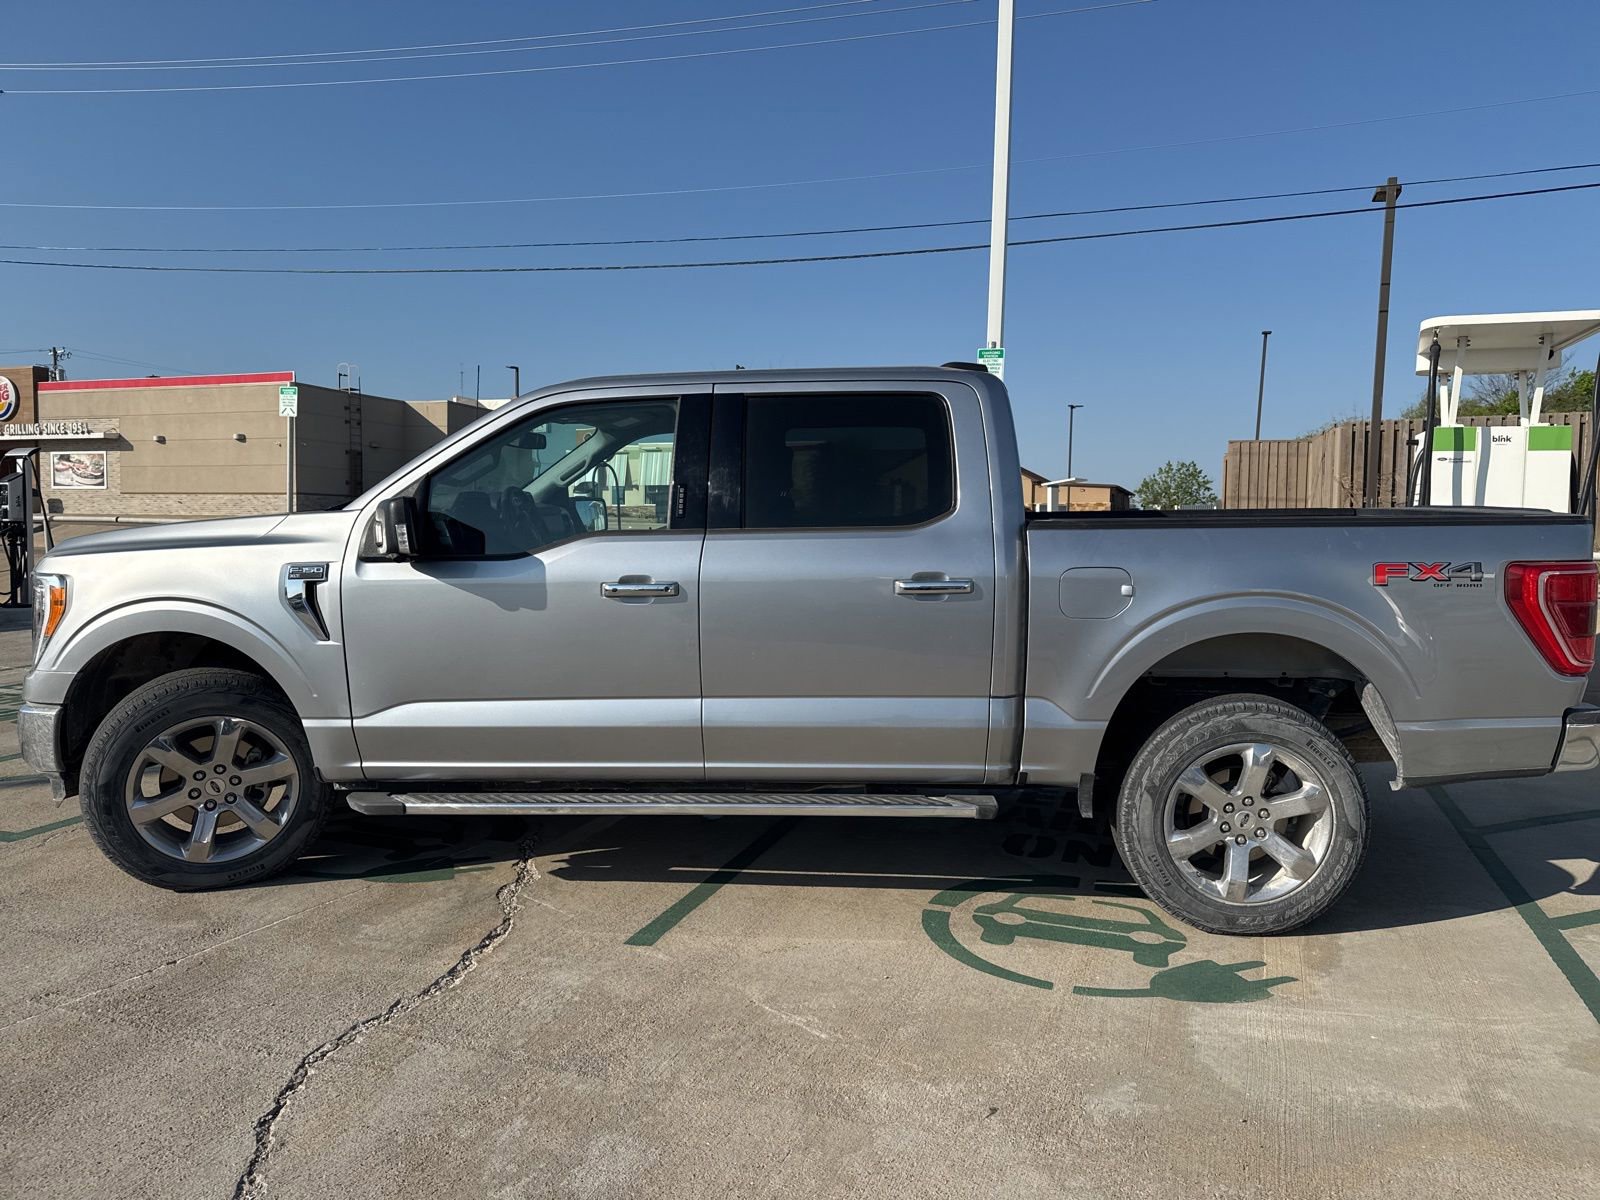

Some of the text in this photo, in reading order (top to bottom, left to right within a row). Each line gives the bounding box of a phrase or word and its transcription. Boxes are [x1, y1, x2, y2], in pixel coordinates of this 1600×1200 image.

[4, 421, 88, 435] GRILLING SINCE 1954
[1492, 434, 1512, 443] blink
[1372, 562, 1484, 587] FX4
